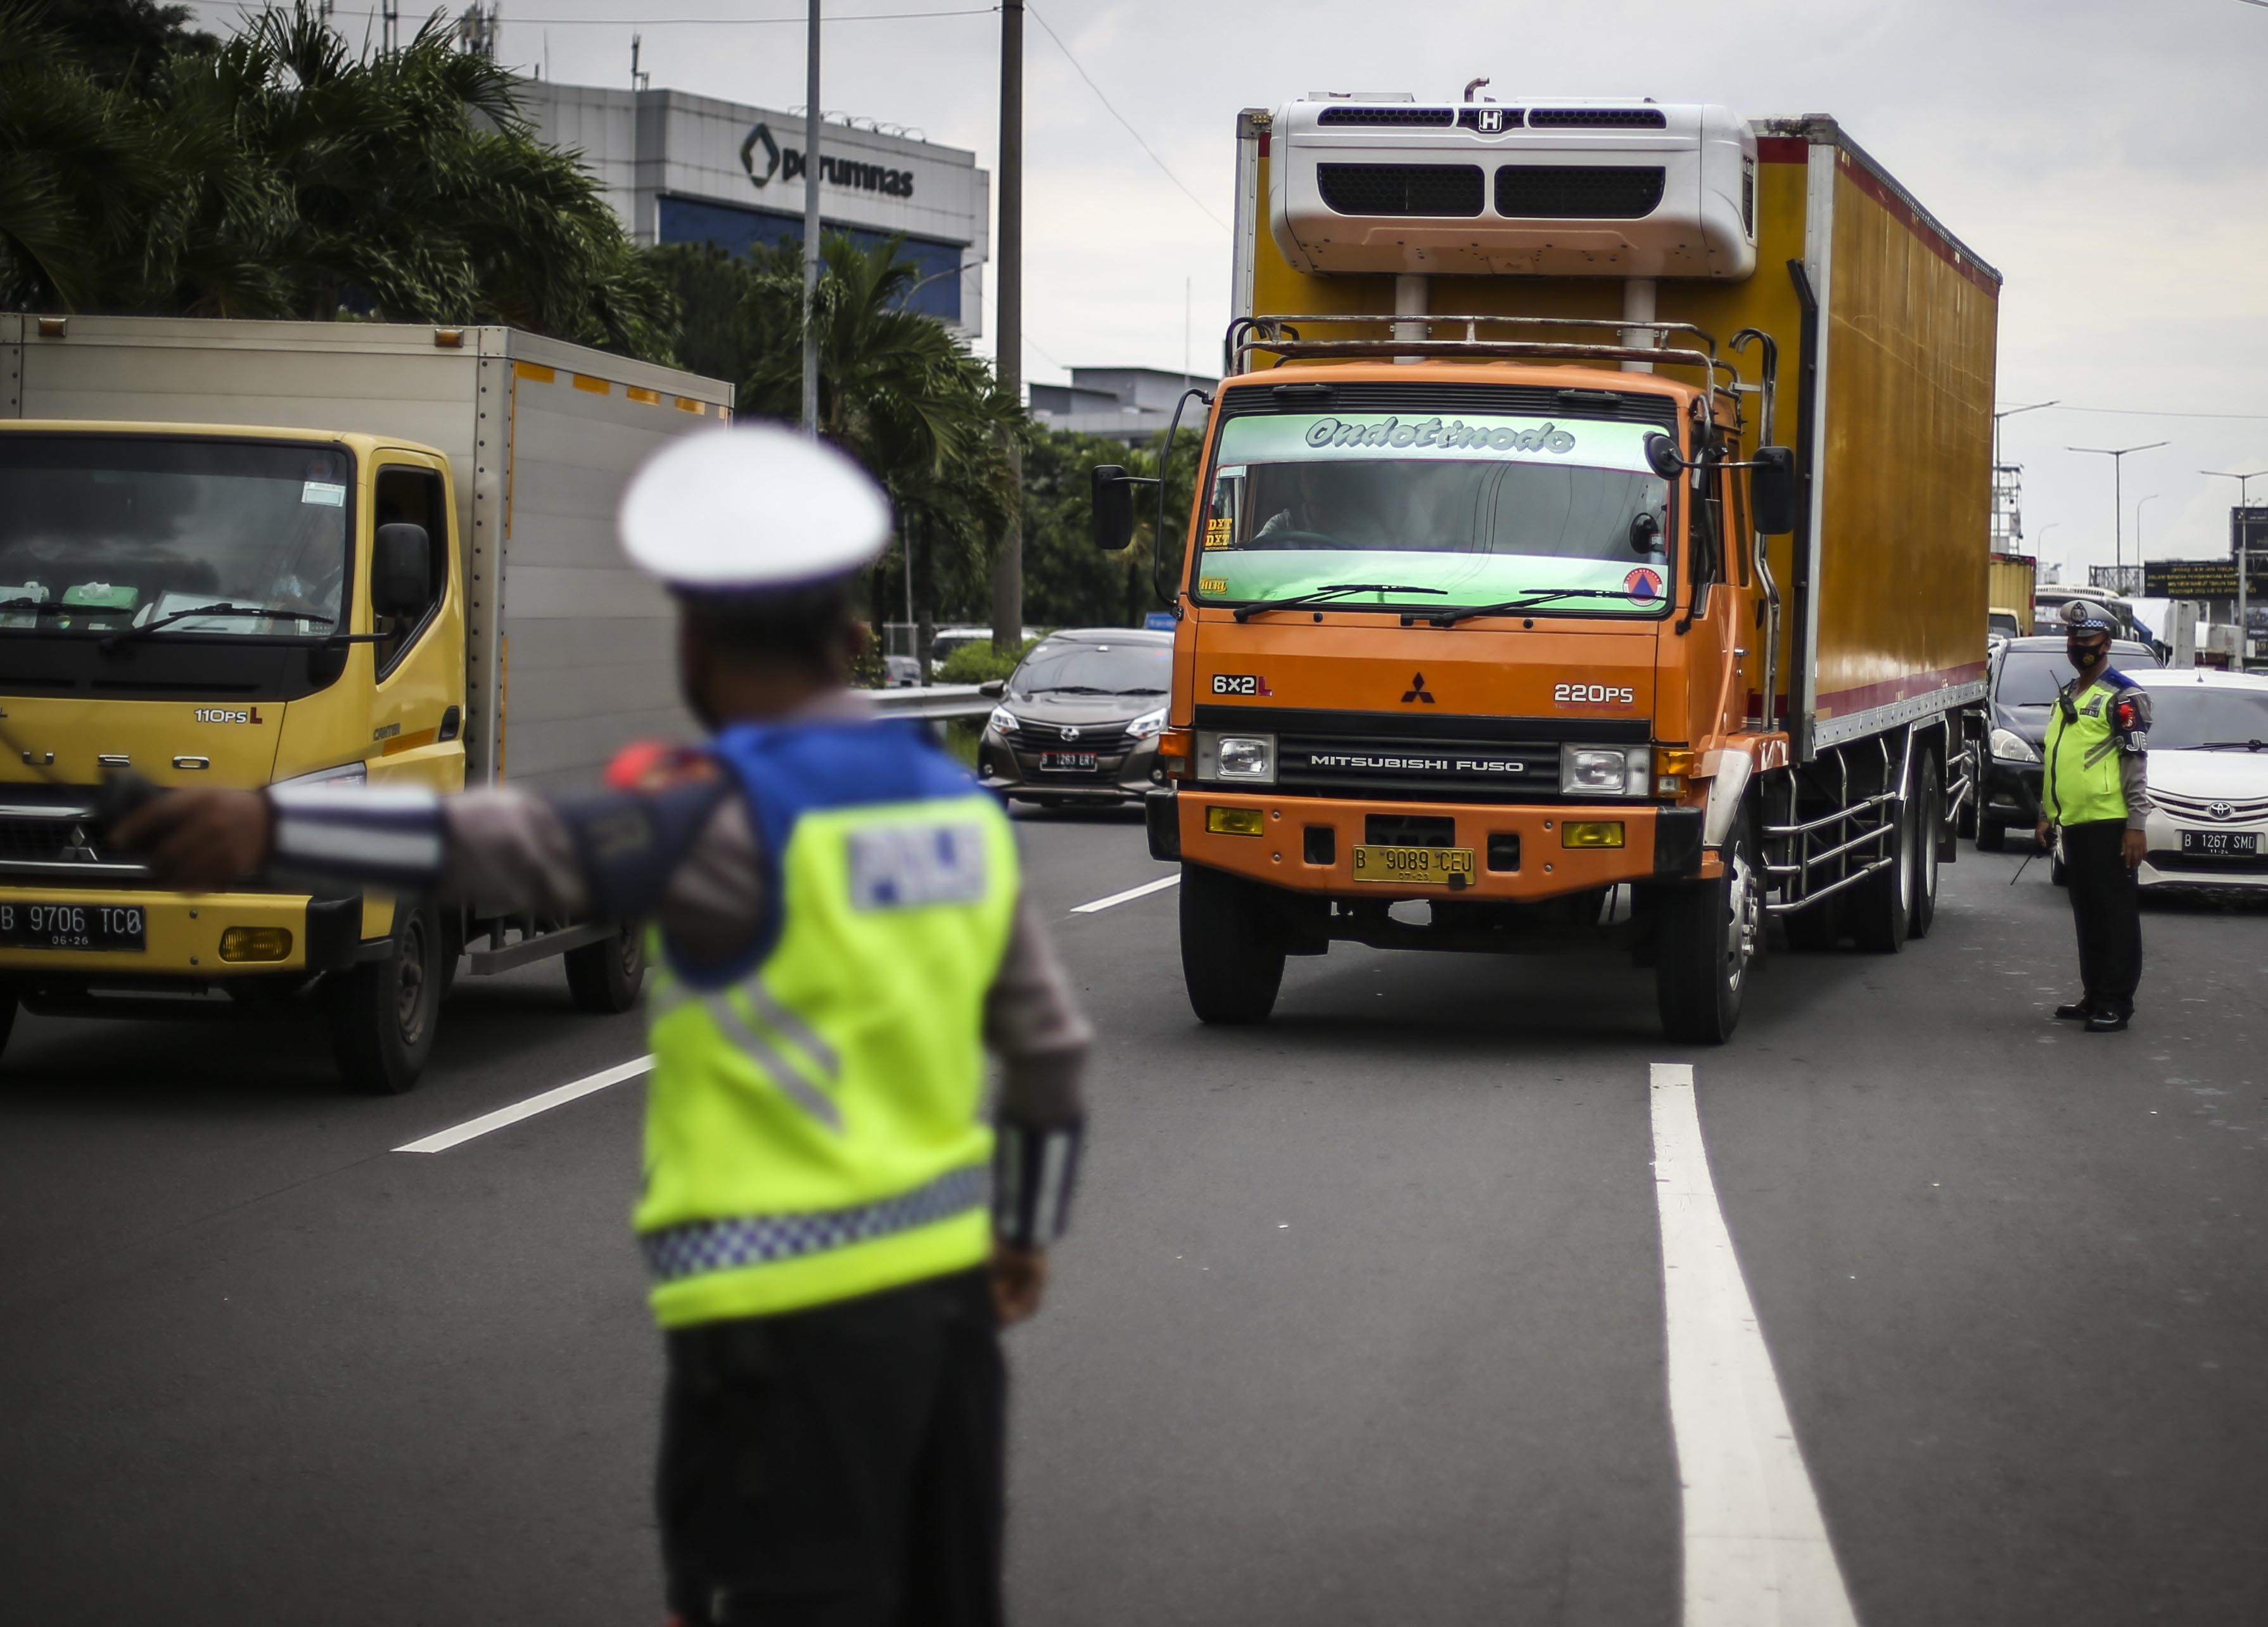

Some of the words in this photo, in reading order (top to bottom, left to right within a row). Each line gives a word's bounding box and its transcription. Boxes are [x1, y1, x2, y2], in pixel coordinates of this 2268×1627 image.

[1305, 416, 1576, 454] Ondotinodo
[1553, 683, 1634, 703] 220PS
[1311, 755, 1448, 769] MITSUBISHI
[1456, 761, 1524, 772] FUSO
[2185, 834, 2191, 846] B
[2202, 834, 2227, 848] 1267
[2233, 836, 2255, 849] SMD
[1356, 848, 1367, 869] B
[1386, 850, 1429, 871] 9089
[1439, 850, 1472, 872] CEU
[1, 906, 14, 930] B
[30, 907, 85, 932] 9706
